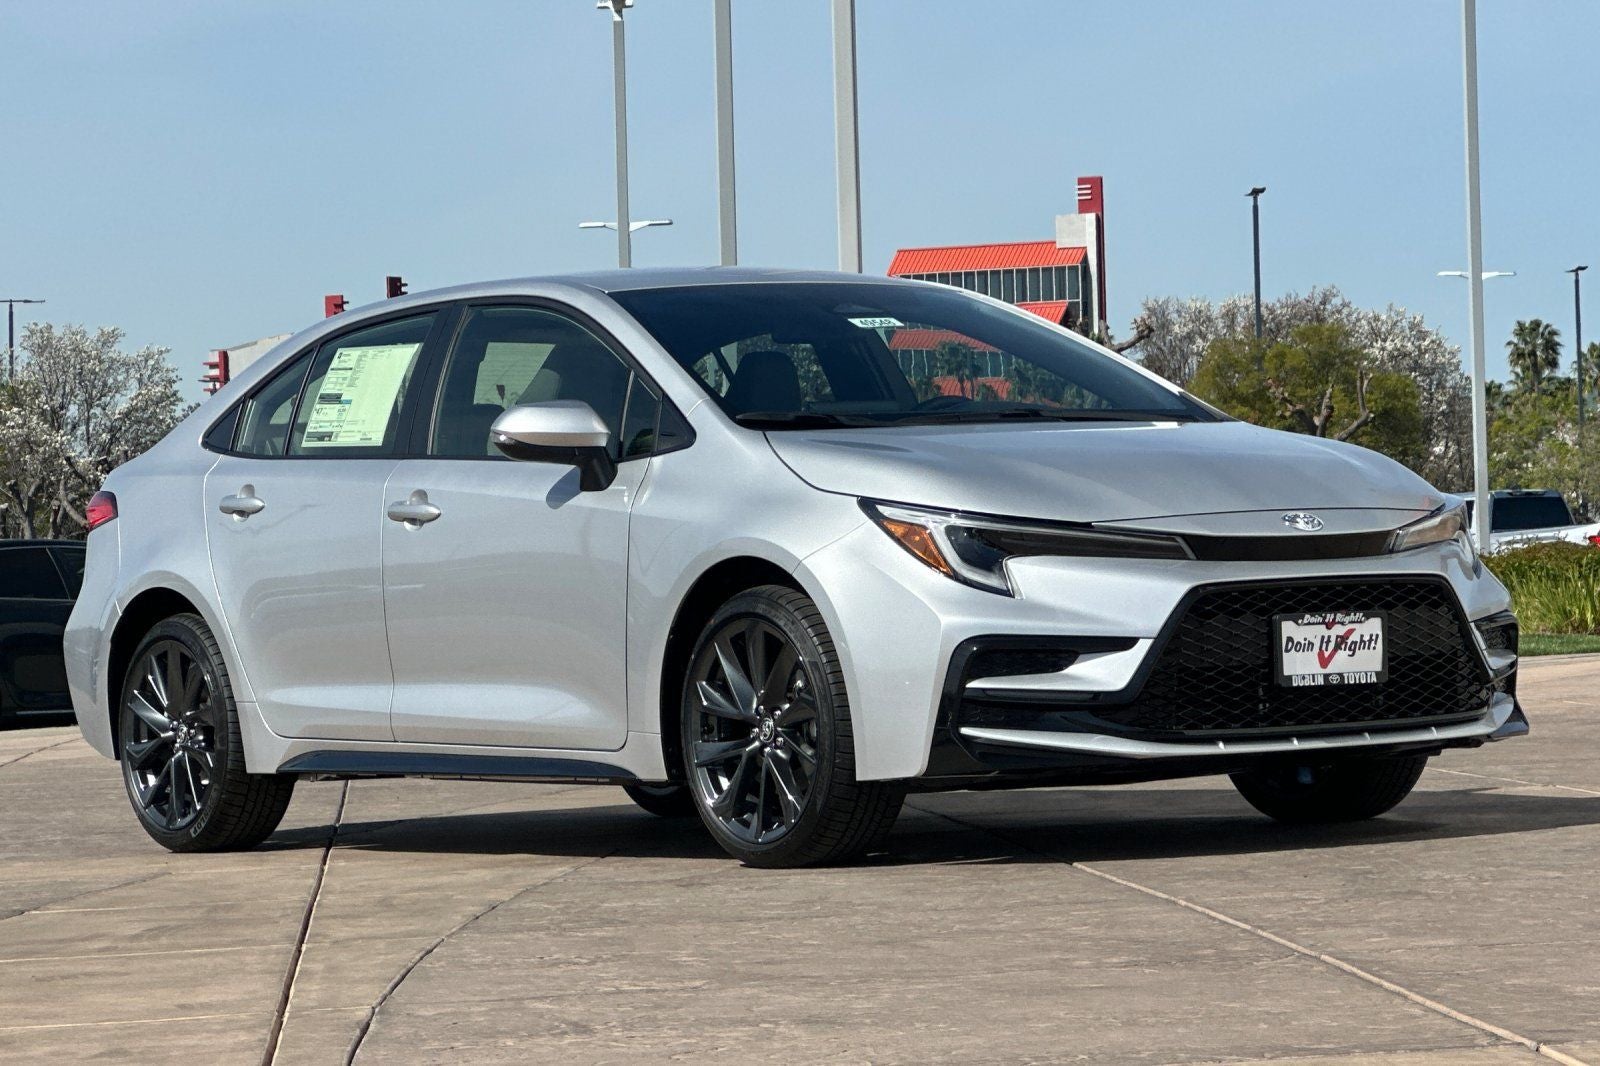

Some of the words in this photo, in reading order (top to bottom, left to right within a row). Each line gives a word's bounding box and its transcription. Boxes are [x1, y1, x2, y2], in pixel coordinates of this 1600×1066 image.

[1325, 612, 1335, 622] It
[1284, 634, 1317, 653] Doin'
[1319, 634, 1332, 652] It
[1334, 633, 1379, 657] Right!
[1292, 674, 1324, 687] DUBLIN
[1343, 672, 1377, 684] TOYOTA
